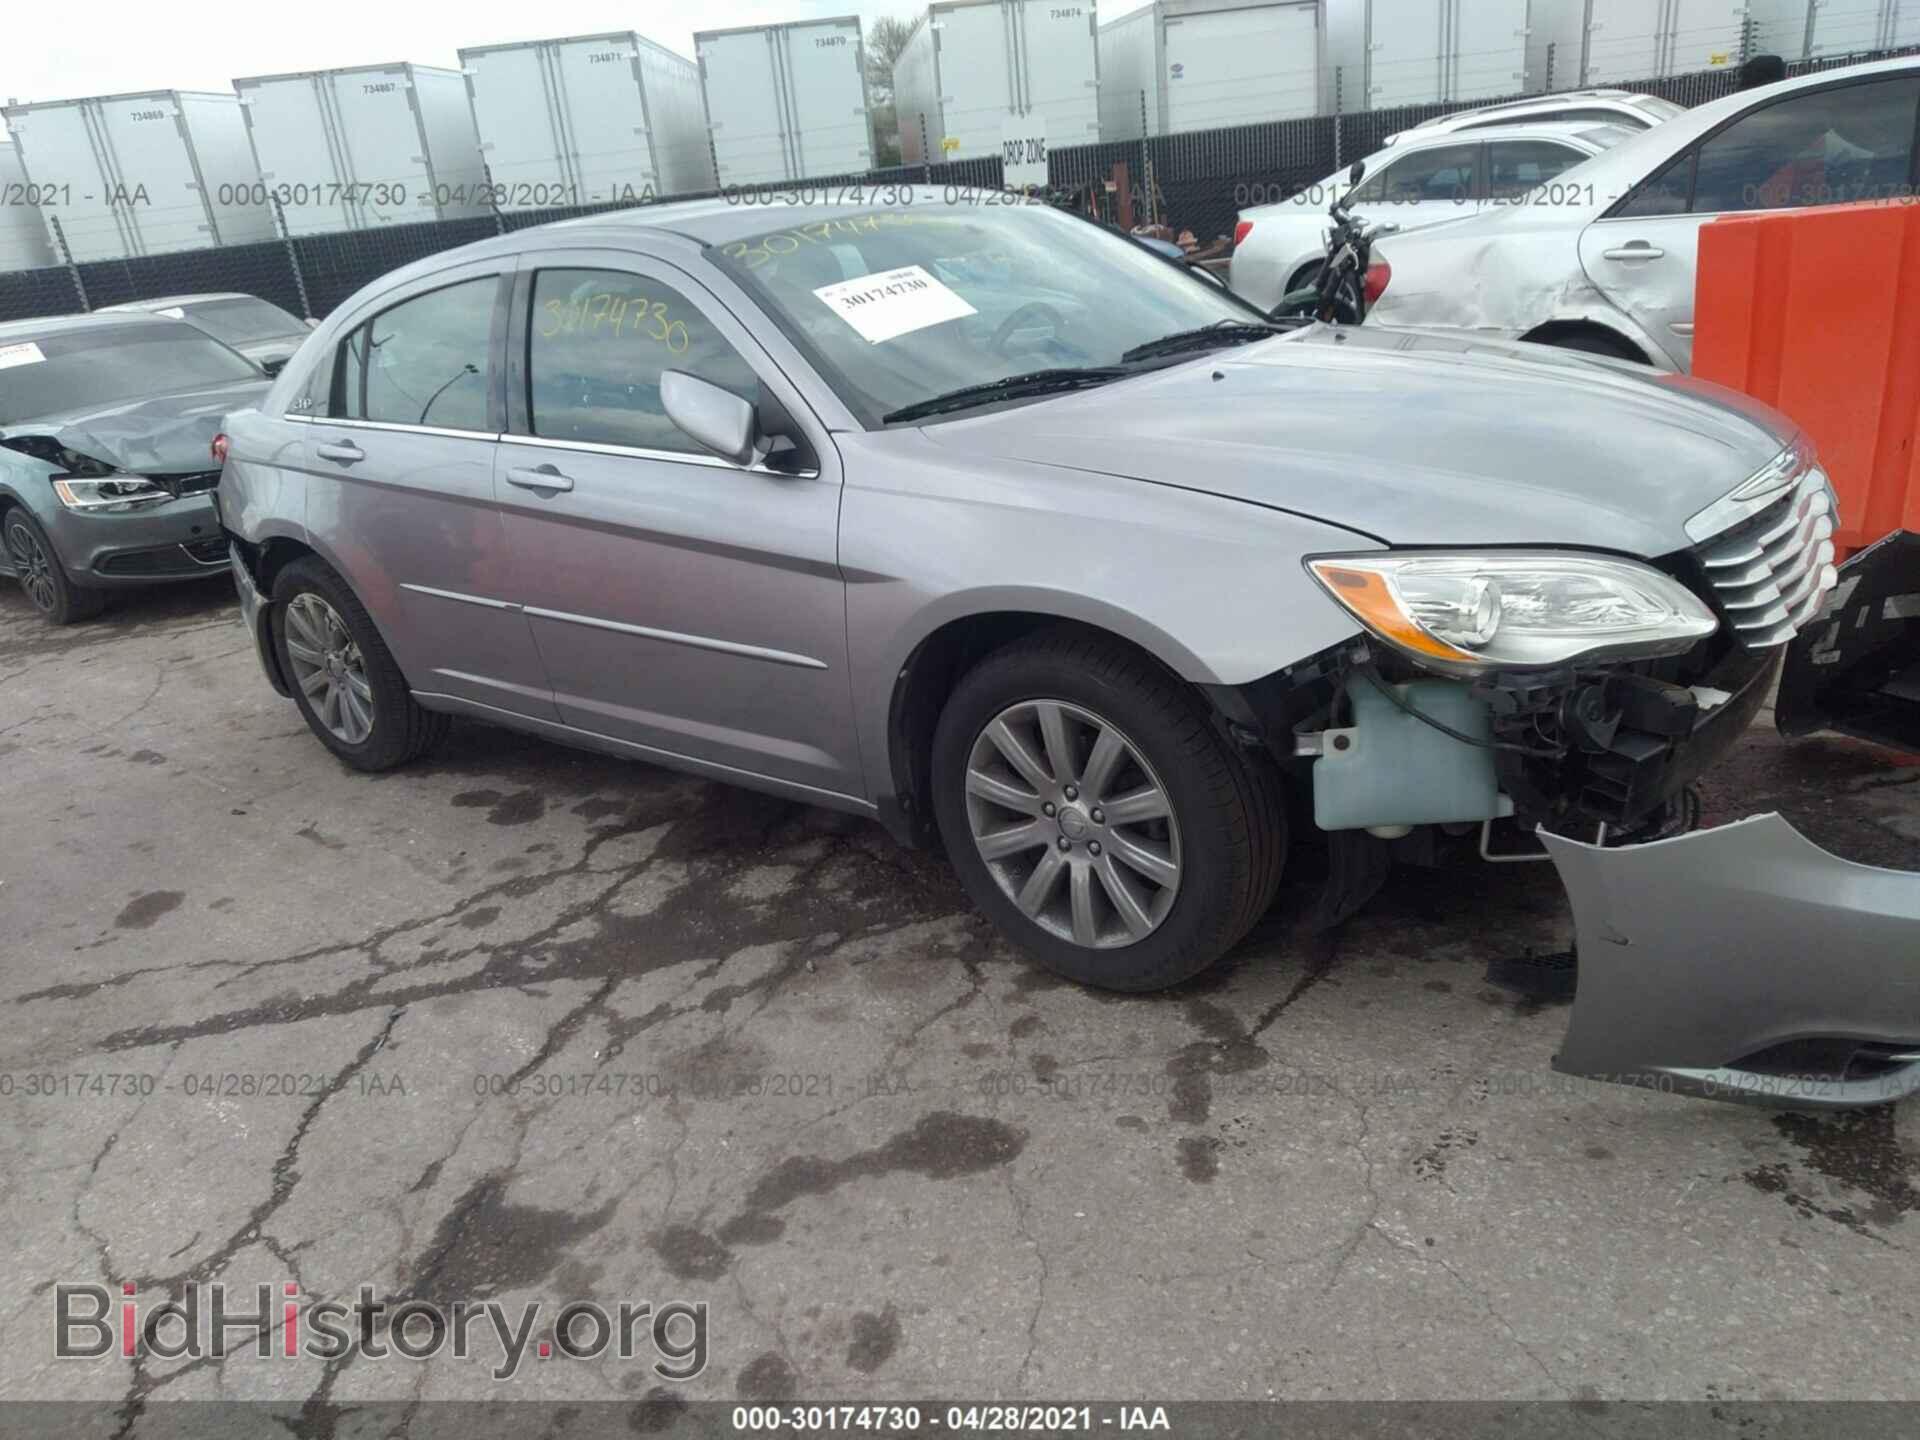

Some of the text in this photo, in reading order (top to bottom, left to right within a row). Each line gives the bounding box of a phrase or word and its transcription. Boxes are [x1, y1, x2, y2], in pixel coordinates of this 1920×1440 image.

[1003, 138, 1046, 165] DROP ZONE
[840, 278, 928, 311] 30174730
